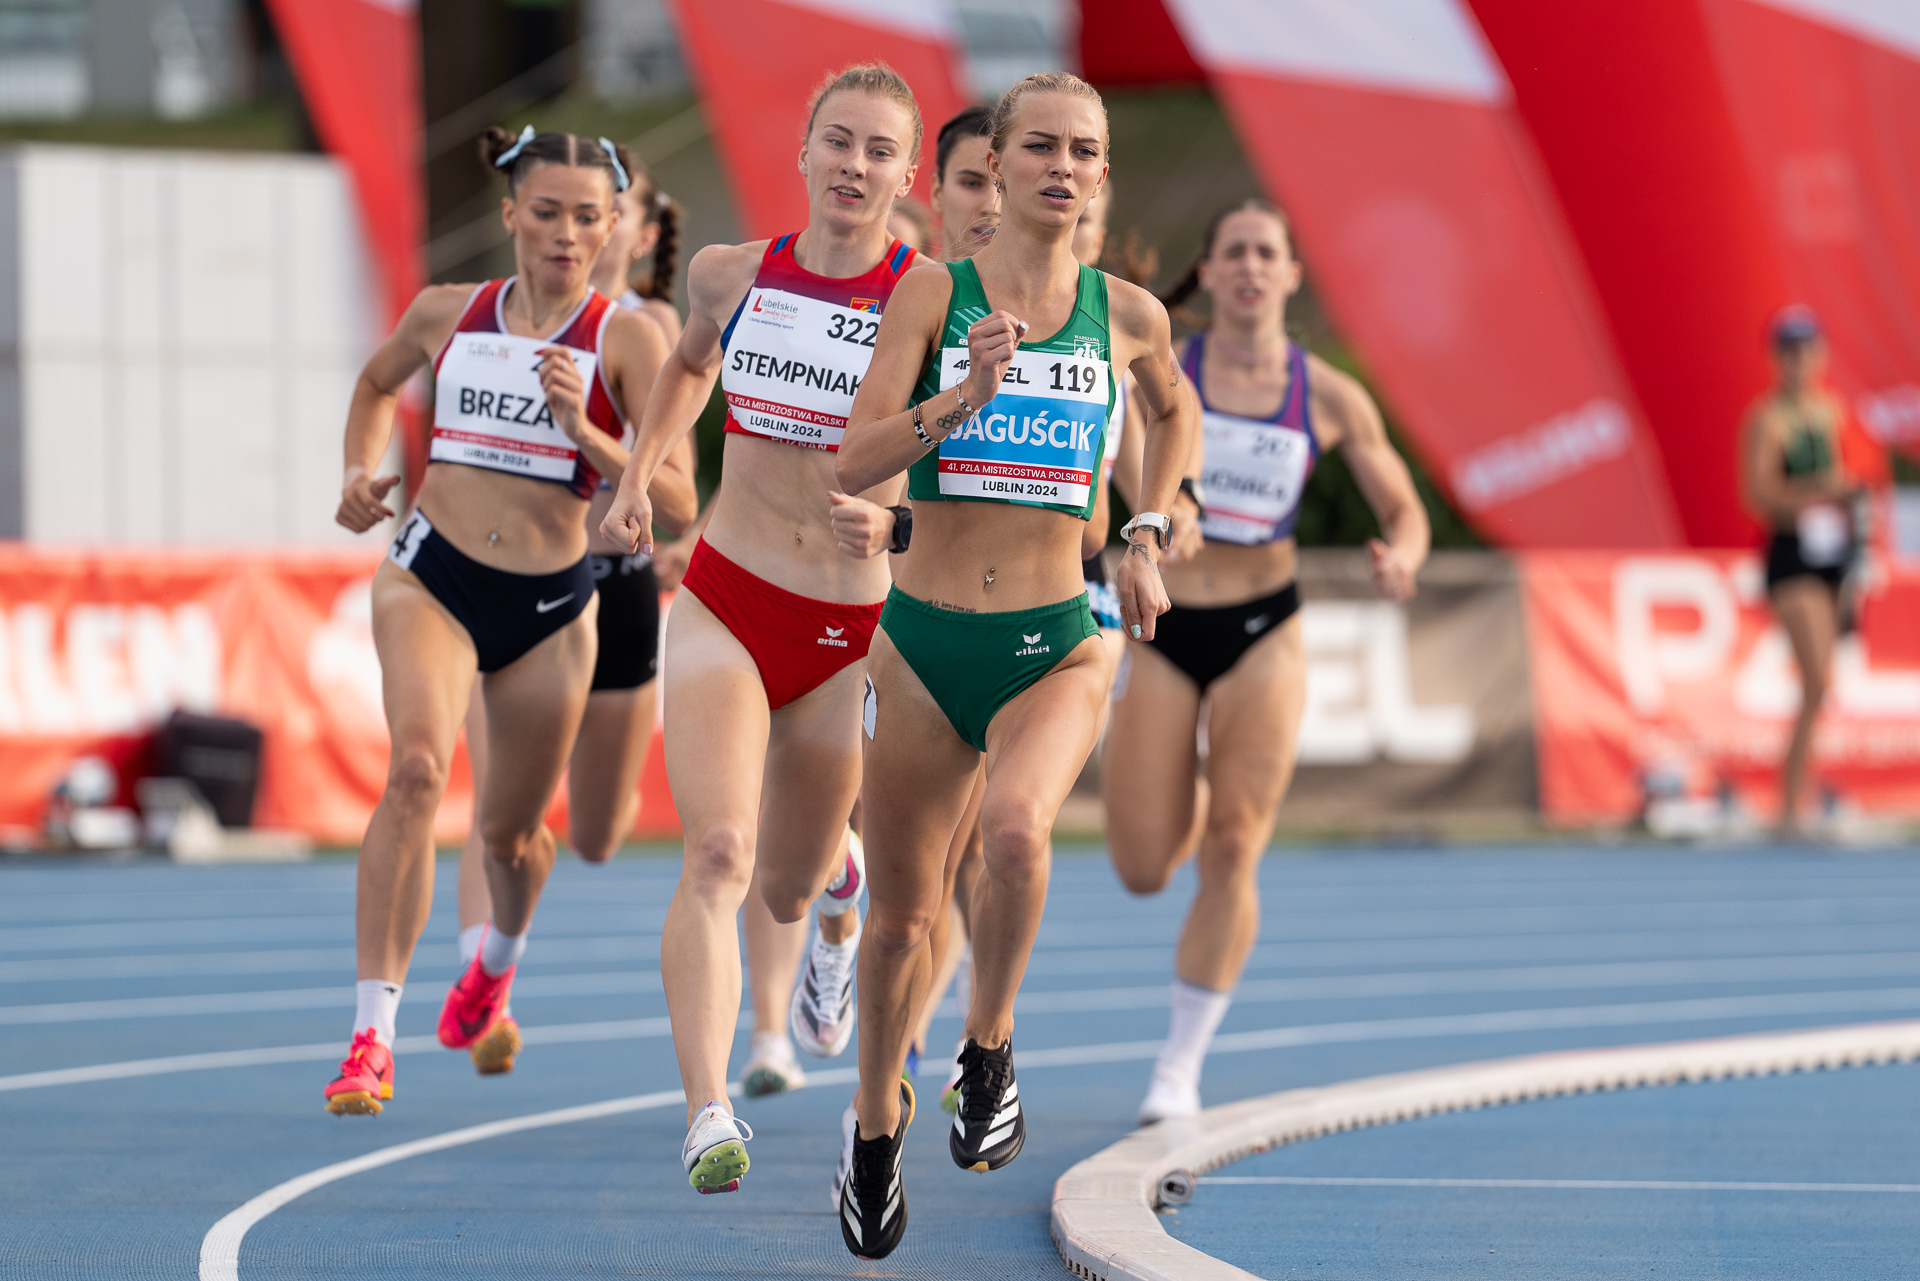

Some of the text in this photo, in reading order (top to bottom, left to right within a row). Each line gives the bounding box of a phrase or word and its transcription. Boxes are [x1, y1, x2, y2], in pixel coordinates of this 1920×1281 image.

[752, 294, 799, 313] Lubelskie
[827, 314, 879, 348] 322
[1074, 334, 1100, 343] WARSZAWA
[1002, 366, 1030, 384] EL
[1049, 362, 1097, 393] 119
[459, 386, 555, 429] BREZA
[735, 396, 750, 408] PZLA
[751, 400, 812, 421] MISTRZOSTWA
[814, 413, 844, 427] POLSKI
[750, 415, 822, 439] LUBLIN 2024
[949, 410, 1096, 452] JAGUŚCIK
[464, 447, 531, 467] LUBLIN 2024
[947, 462, 958, 472] 41.
[960, 463, 980, 473] PZLA
[982, 465, 1046, 479] MISTRZOSTWA
[1048, 471, 1078, 482] POLSKI
[982, 480, 1058, 497] LUBLIN 2024
[395, 518, 418, 558] 4
[817, 637, 848, 648] erima
